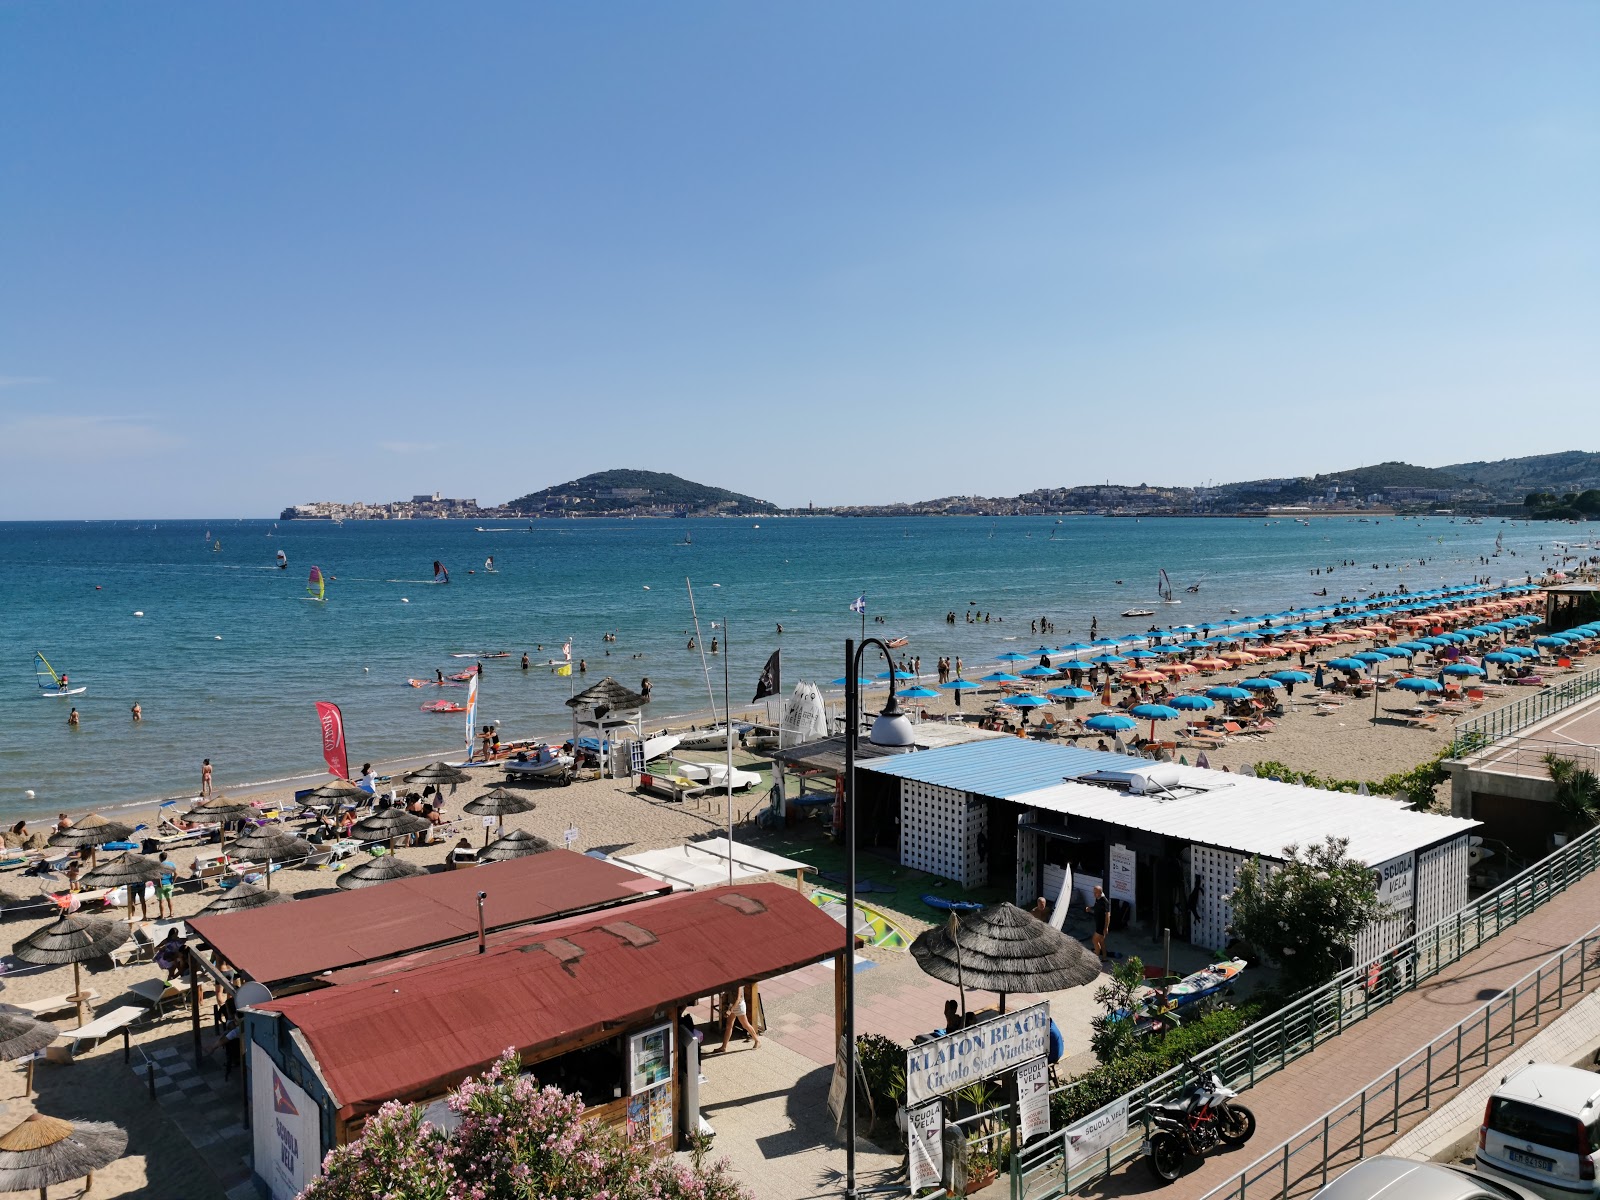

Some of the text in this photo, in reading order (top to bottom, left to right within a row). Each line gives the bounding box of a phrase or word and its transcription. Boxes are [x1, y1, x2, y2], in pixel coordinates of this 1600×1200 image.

[1384, 856, 1412, 880] SCUOLA
[1390, 874, 1407, 893] VELA
[909, 1009, 1047, 1075] KLATON BEACH
[926, 1034, 1045, 1090] Circolo Surf Vindicio
[1018, 1061, 1046, 1079] SCUOLA
[1024, 1071, 1042, 1084] VELA
[909, 1105, 940, 1123] SCUOLA
[914, 1117, 935, 1129] VELA
[1111, 1107, 1126, 1121] VELA
[1085, 1117, 1110, 1135] SCUOLA
[275, 1117, 299, 1159] SCUOLA
[281, 1142, 295, 1176] VELA
